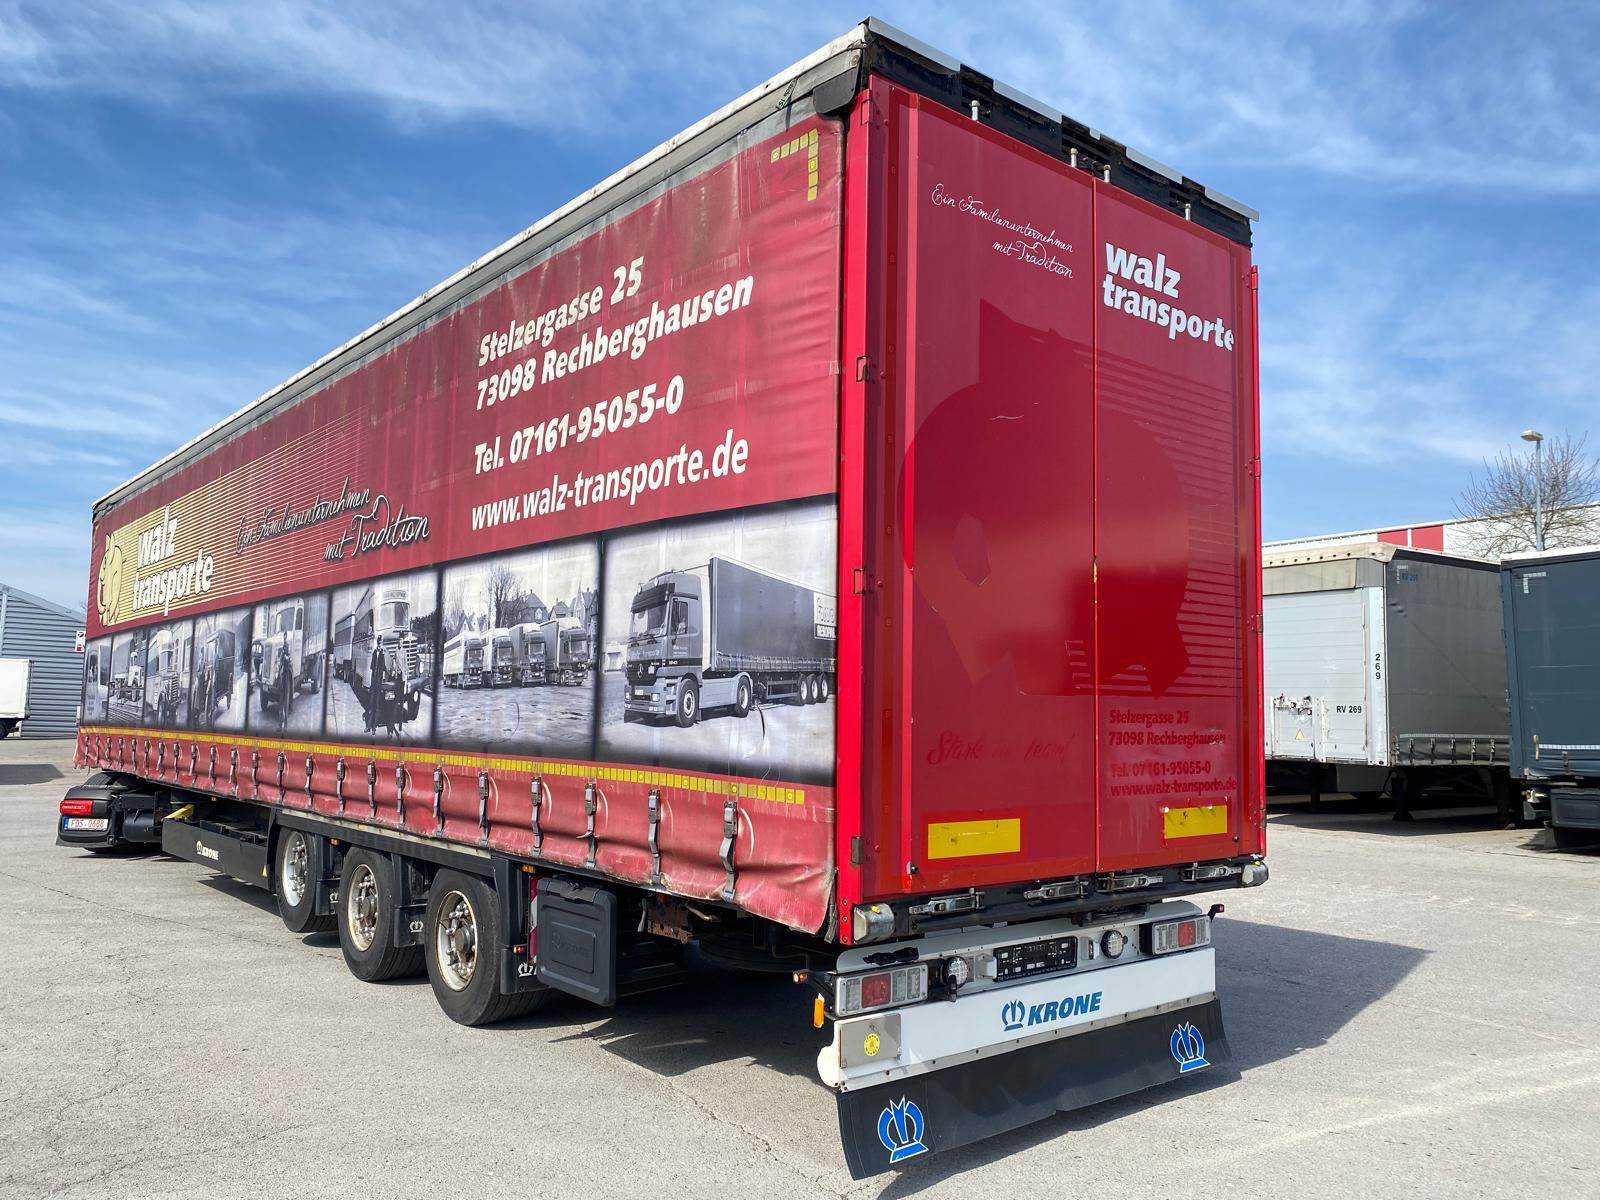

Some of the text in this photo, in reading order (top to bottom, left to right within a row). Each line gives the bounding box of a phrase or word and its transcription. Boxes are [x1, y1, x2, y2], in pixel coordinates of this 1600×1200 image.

[931, 183, 1074, 253] Ein Familienunternehmen
[992, 239, 1074, 279] mit Tradition
[1104, 242, 1182, 299] walz
[476, 275, 754, 411] 73098 Rechberghausen
[478, 256, 644, 367] Stelzergasse 25
[1102, 274, 1235, 352] transporte
[474, 375, 684, 474] Tel. 07161-95055-0
[472, 429, 749, 531] www.walz-transporte.de
[137, 505, 178, 569] walz
[236, 477, 370, 553] Ein Familienunternehmen
[323, 495, 429, 561] mit Tradition
[133, 548, 214, 617] transporte
[1108, 730, 1226, 749] 73098 Rechberghausen
[1109, 709, 1190, 728] Stelzergasse 25
[1336, 705, 1362, 713] RV 269
[1110, 776, 1237, 796] www.walz-transporte.de
[1027, 991, 1102, 1027] KRONE
